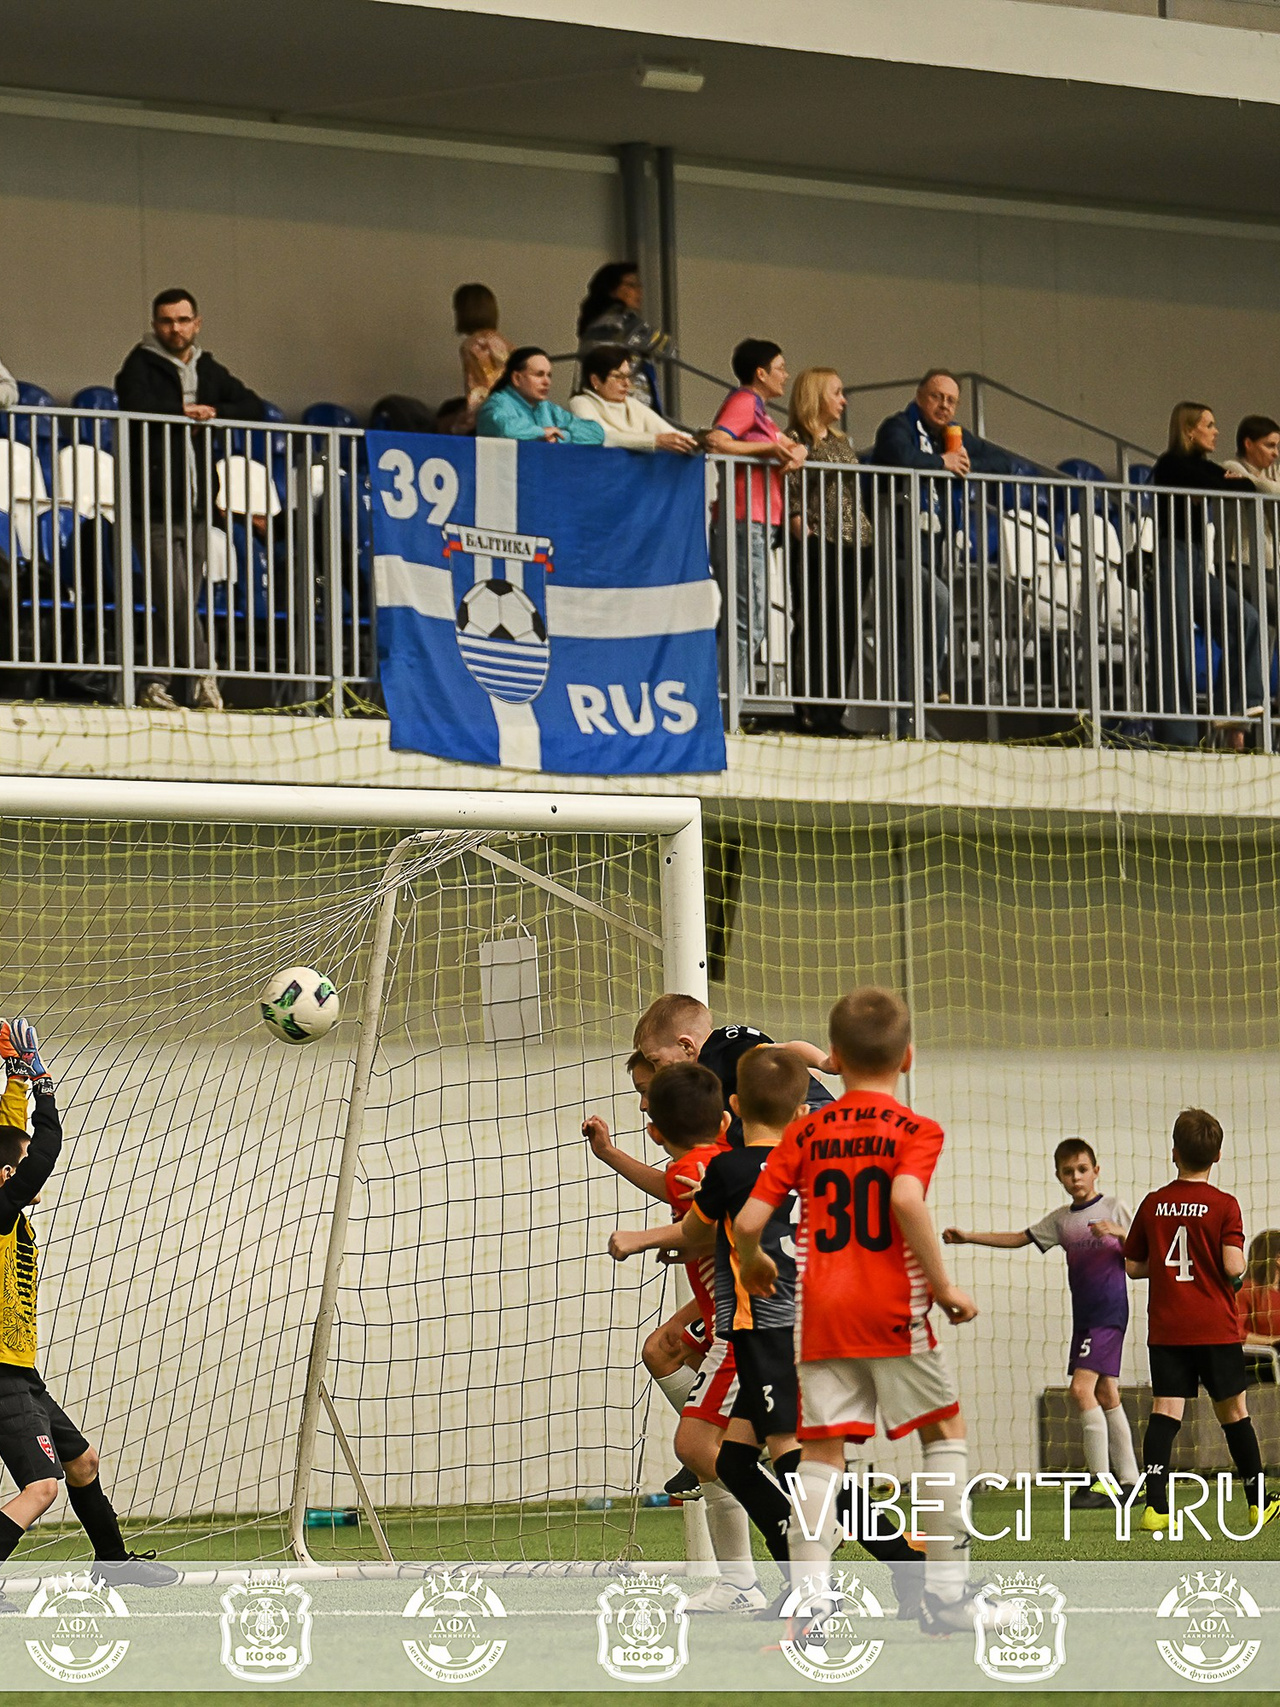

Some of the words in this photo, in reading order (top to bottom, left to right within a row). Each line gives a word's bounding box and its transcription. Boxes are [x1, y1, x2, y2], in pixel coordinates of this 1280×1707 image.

[378, 449, 459, 525] 39
[465, 533, 531, 556] БАЛТИКА
[566, 680, 698, 736] RUS
[814, 1165, 892, 1253] 30
[1155, 1202, 1209, 1218] МАЛЯР
[1164, 1225, 1195, 1282] 4
[1078, 1338, 1092, 1358] 5
[762, 1384, 775, 1413] 3
